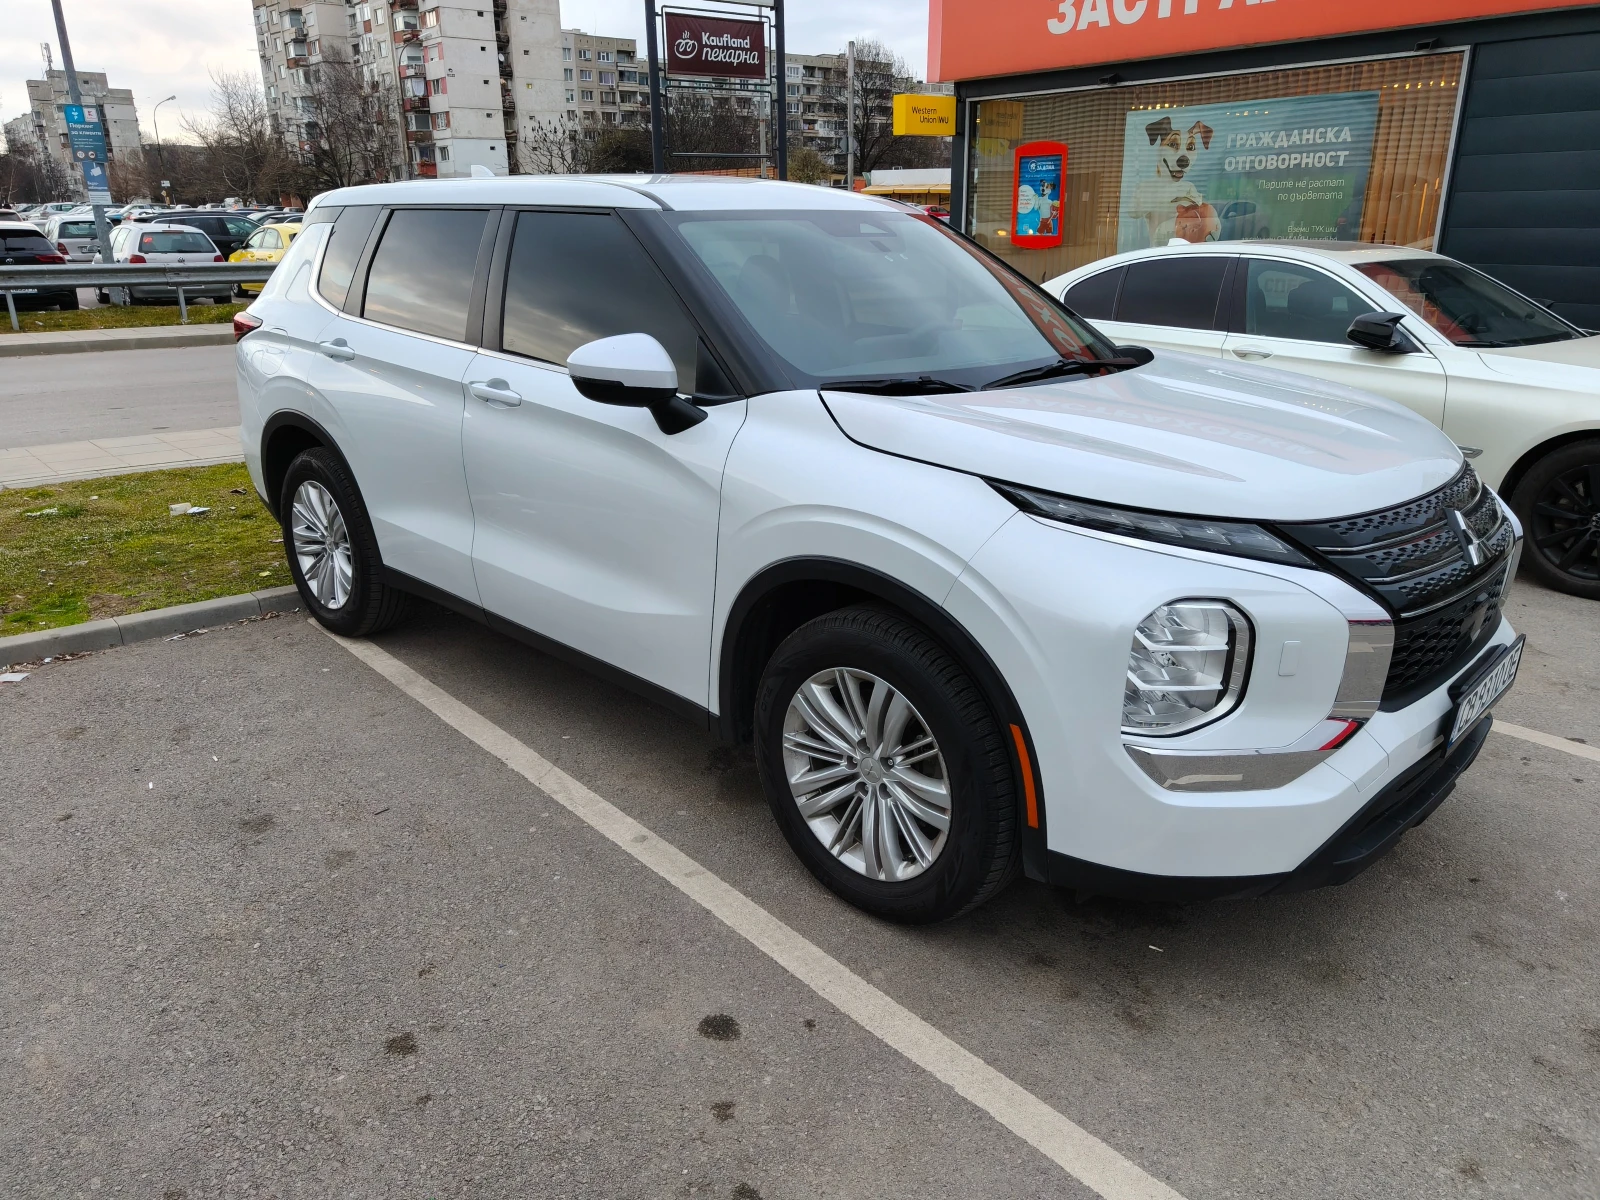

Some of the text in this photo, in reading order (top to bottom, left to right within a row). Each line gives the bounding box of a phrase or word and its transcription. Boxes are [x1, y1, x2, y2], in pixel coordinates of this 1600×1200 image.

[702, 32, 750, 48] Kaufland
[702, 48, 759, 66] пекарна
[912, 106, 937, 114] Western
[920, 115, 936, 123] Union
[1226, 127, 1351, 149] ГРАЖДАНСКА
[1224, 151, 1350, 171] ОТГОВОРНОСТ
[1258, 179, 1345, 190] Парите не растат
[1289, 190, 1343, 202] дърветата
[1311, 225, 1324, 233] ТУК
